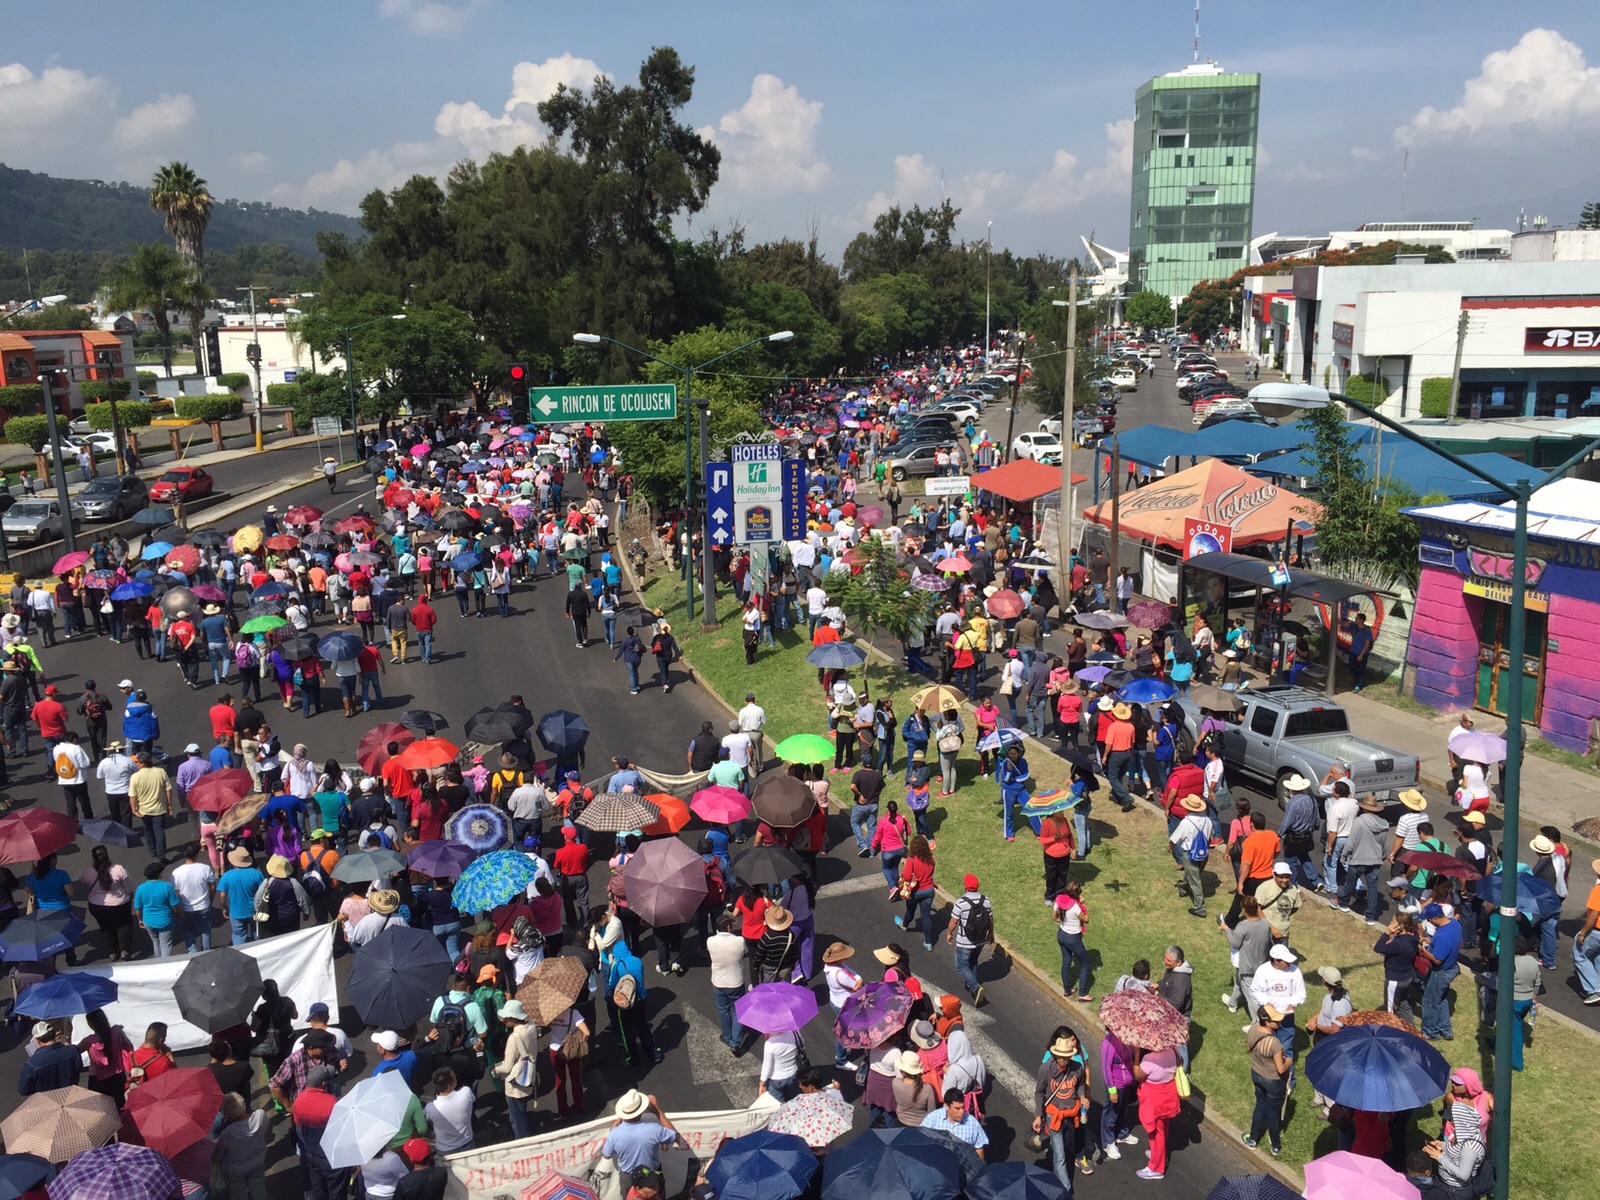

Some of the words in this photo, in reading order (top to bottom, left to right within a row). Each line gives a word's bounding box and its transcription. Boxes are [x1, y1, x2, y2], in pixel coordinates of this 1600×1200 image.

[562, 394, 600, 414] RINCON
[603, 394, 616, 412] DE
[620, 392, 671, 412] OCOLUSEN
[734, 445, 779, 461] HOTELES
[736, 484, 767, 495] Holiday
[767, 484, 780, 493] Inn
[791, 463, 800, 537] BIENVENIDOS
[1203, 478, 1278, 532] Victoria
[1528, 590, 1549, 602] BAJA
